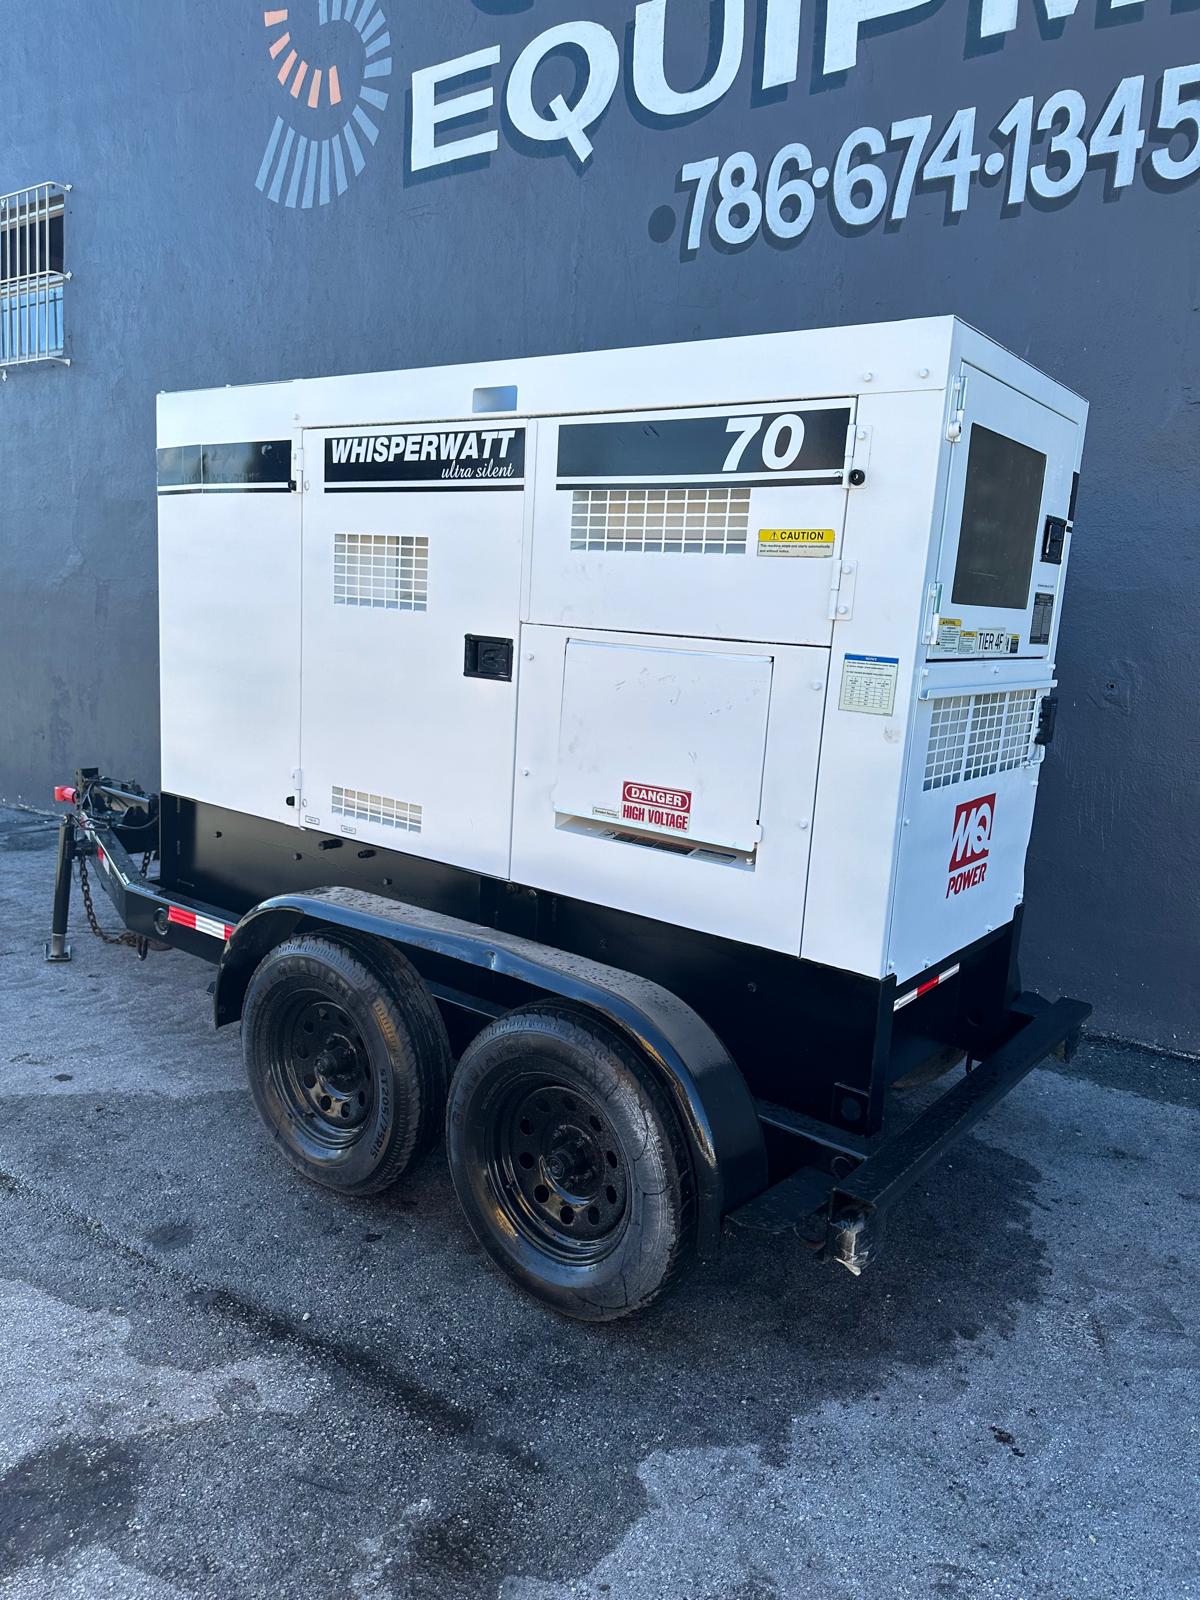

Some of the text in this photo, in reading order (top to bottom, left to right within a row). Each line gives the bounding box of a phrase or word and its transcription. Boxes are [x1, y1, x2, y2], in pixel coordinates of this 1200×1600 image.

[411, 0, 1146, 172] EQUIP
[331, 430, 516, 464] WHISPERWATT
[722, 413, 805, 472] 70
[441, 458, 515, 478] ultra silent
[780, 531, 824, 541] CAUTION
[978, 632, 995, 650] TIER
[995, 633, 1004, 650] 4F
[631, 787, 682, 806] DANGER
[622, 804, 645, 822] HIGH
[648, 809, 688, 830] VOLTAGE
[951, 802, 992, 862] MQ
[945, 862, 988, 899] POWER
